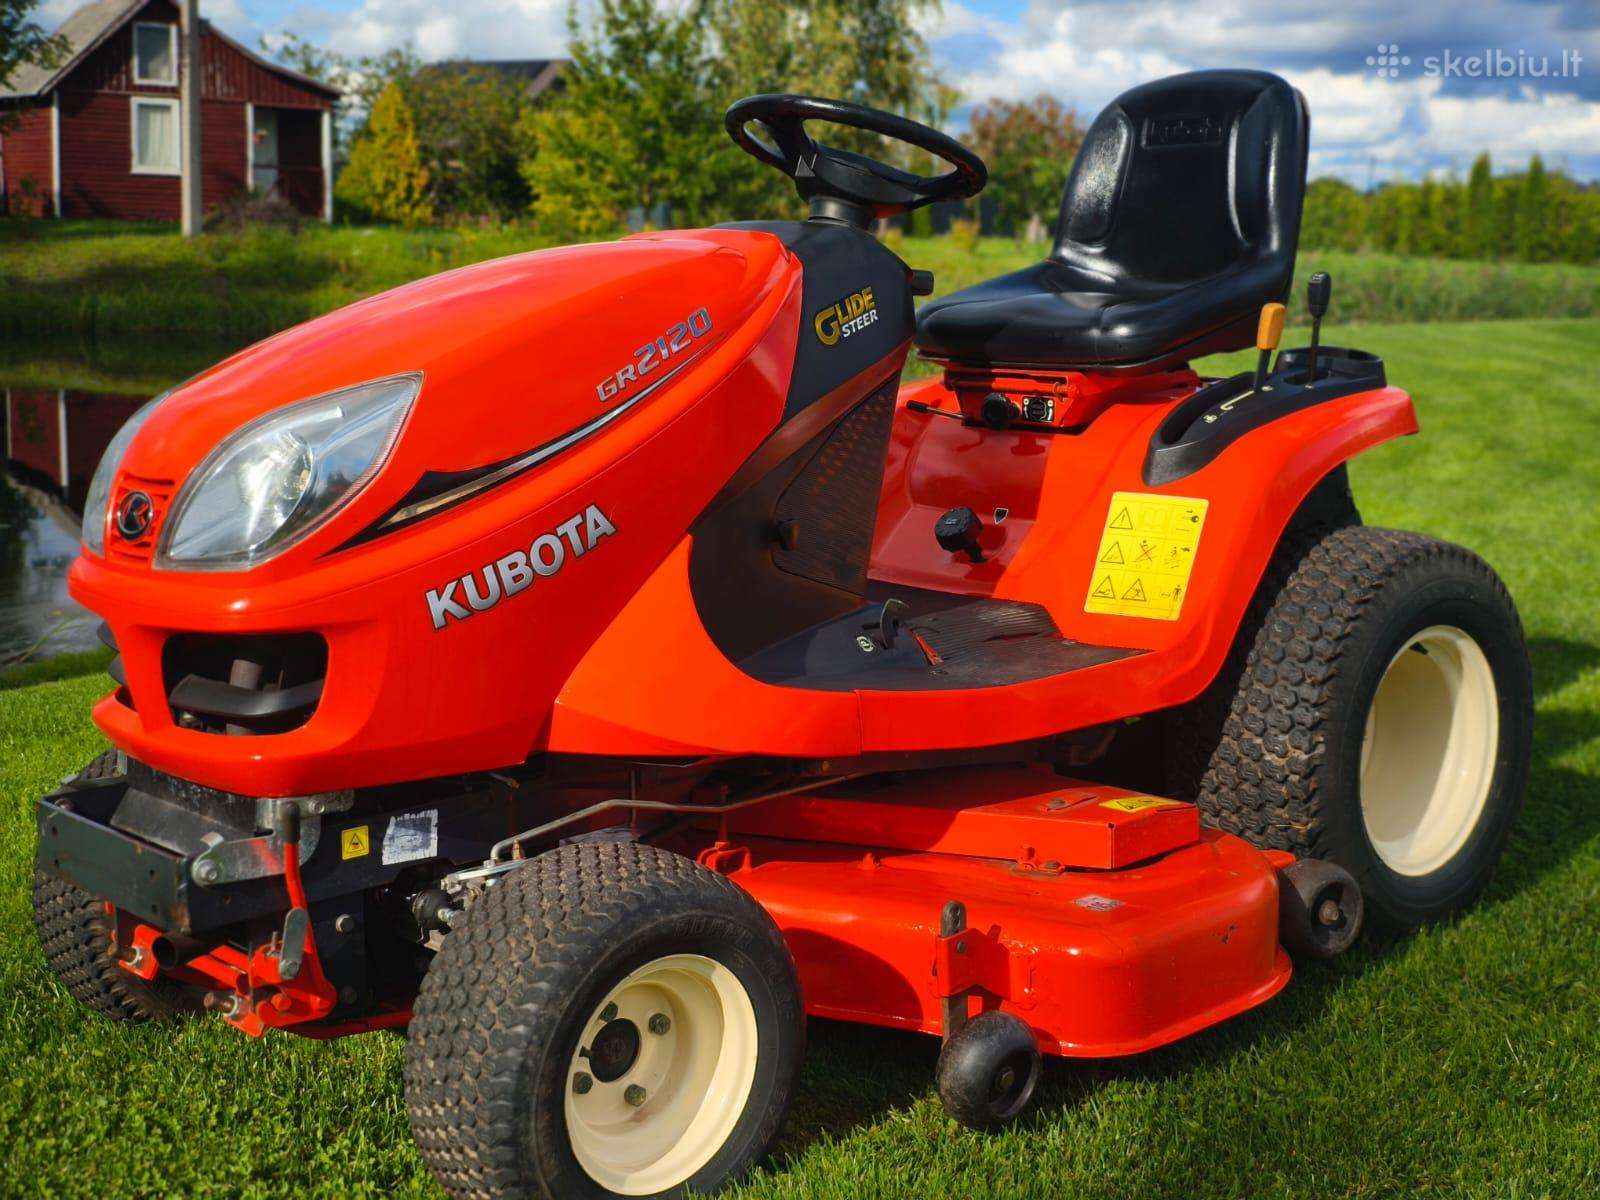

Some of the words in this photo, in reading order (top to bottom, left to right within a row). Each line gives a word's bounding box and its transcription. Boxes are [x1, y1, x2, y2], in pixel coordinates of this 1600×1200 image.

[596, 306, 713, 402] GR2120
[814, 286, 876, 346] GLIDE
[841, 309, 879, 338] STEER
[425, 503, 617, 631] KUBOTA
